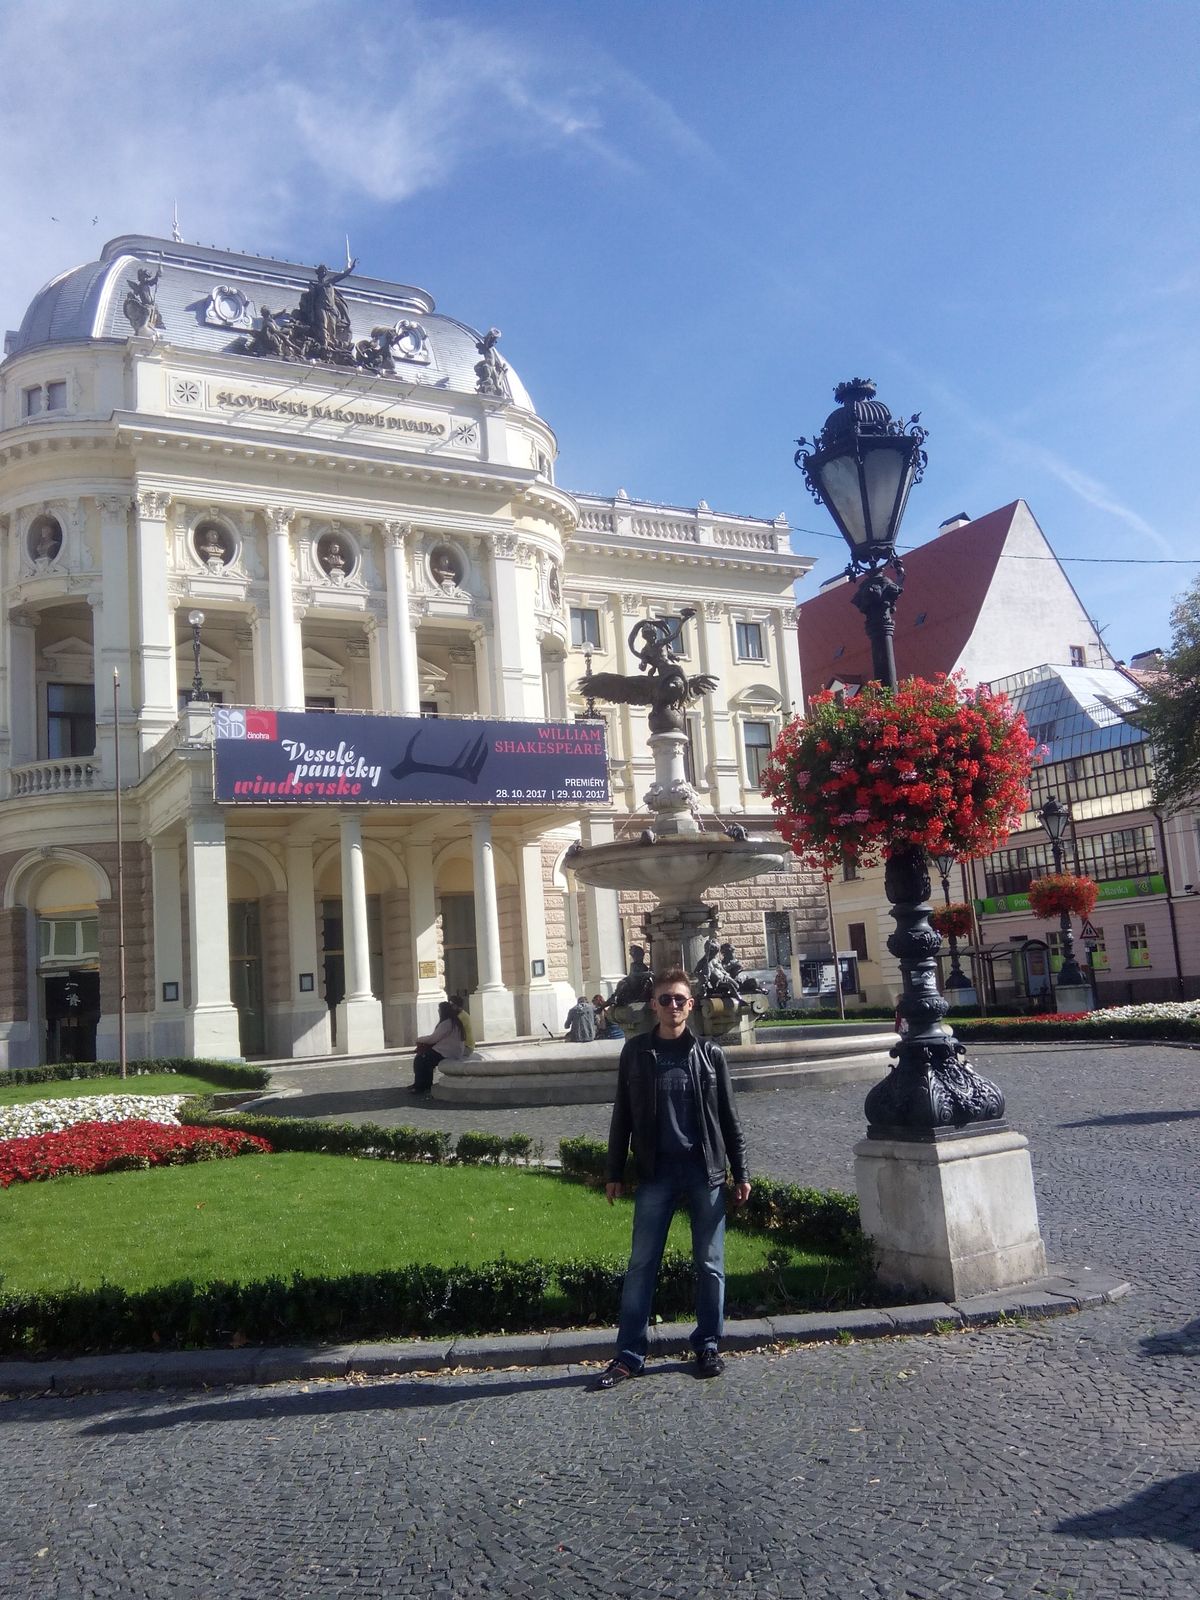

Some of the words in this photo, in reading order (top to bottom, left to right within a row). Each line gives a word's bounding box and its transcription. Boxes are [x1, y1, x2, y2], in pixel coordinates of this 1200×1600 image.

[216, 392, 308, 417] SLOVENSKÉ
[386, 416, 446, 436] DIVADLO
[247, 731, 270, 740] činohra
[538, 727, 600, 740] WILLIAM
[281, 739, 355, 763] Veselé
[495, 741, 602, 755] SHAKESPEARE
[292, 757, 381, 787] paničky
[565, 777, 605, 787] PREMIÉRY
